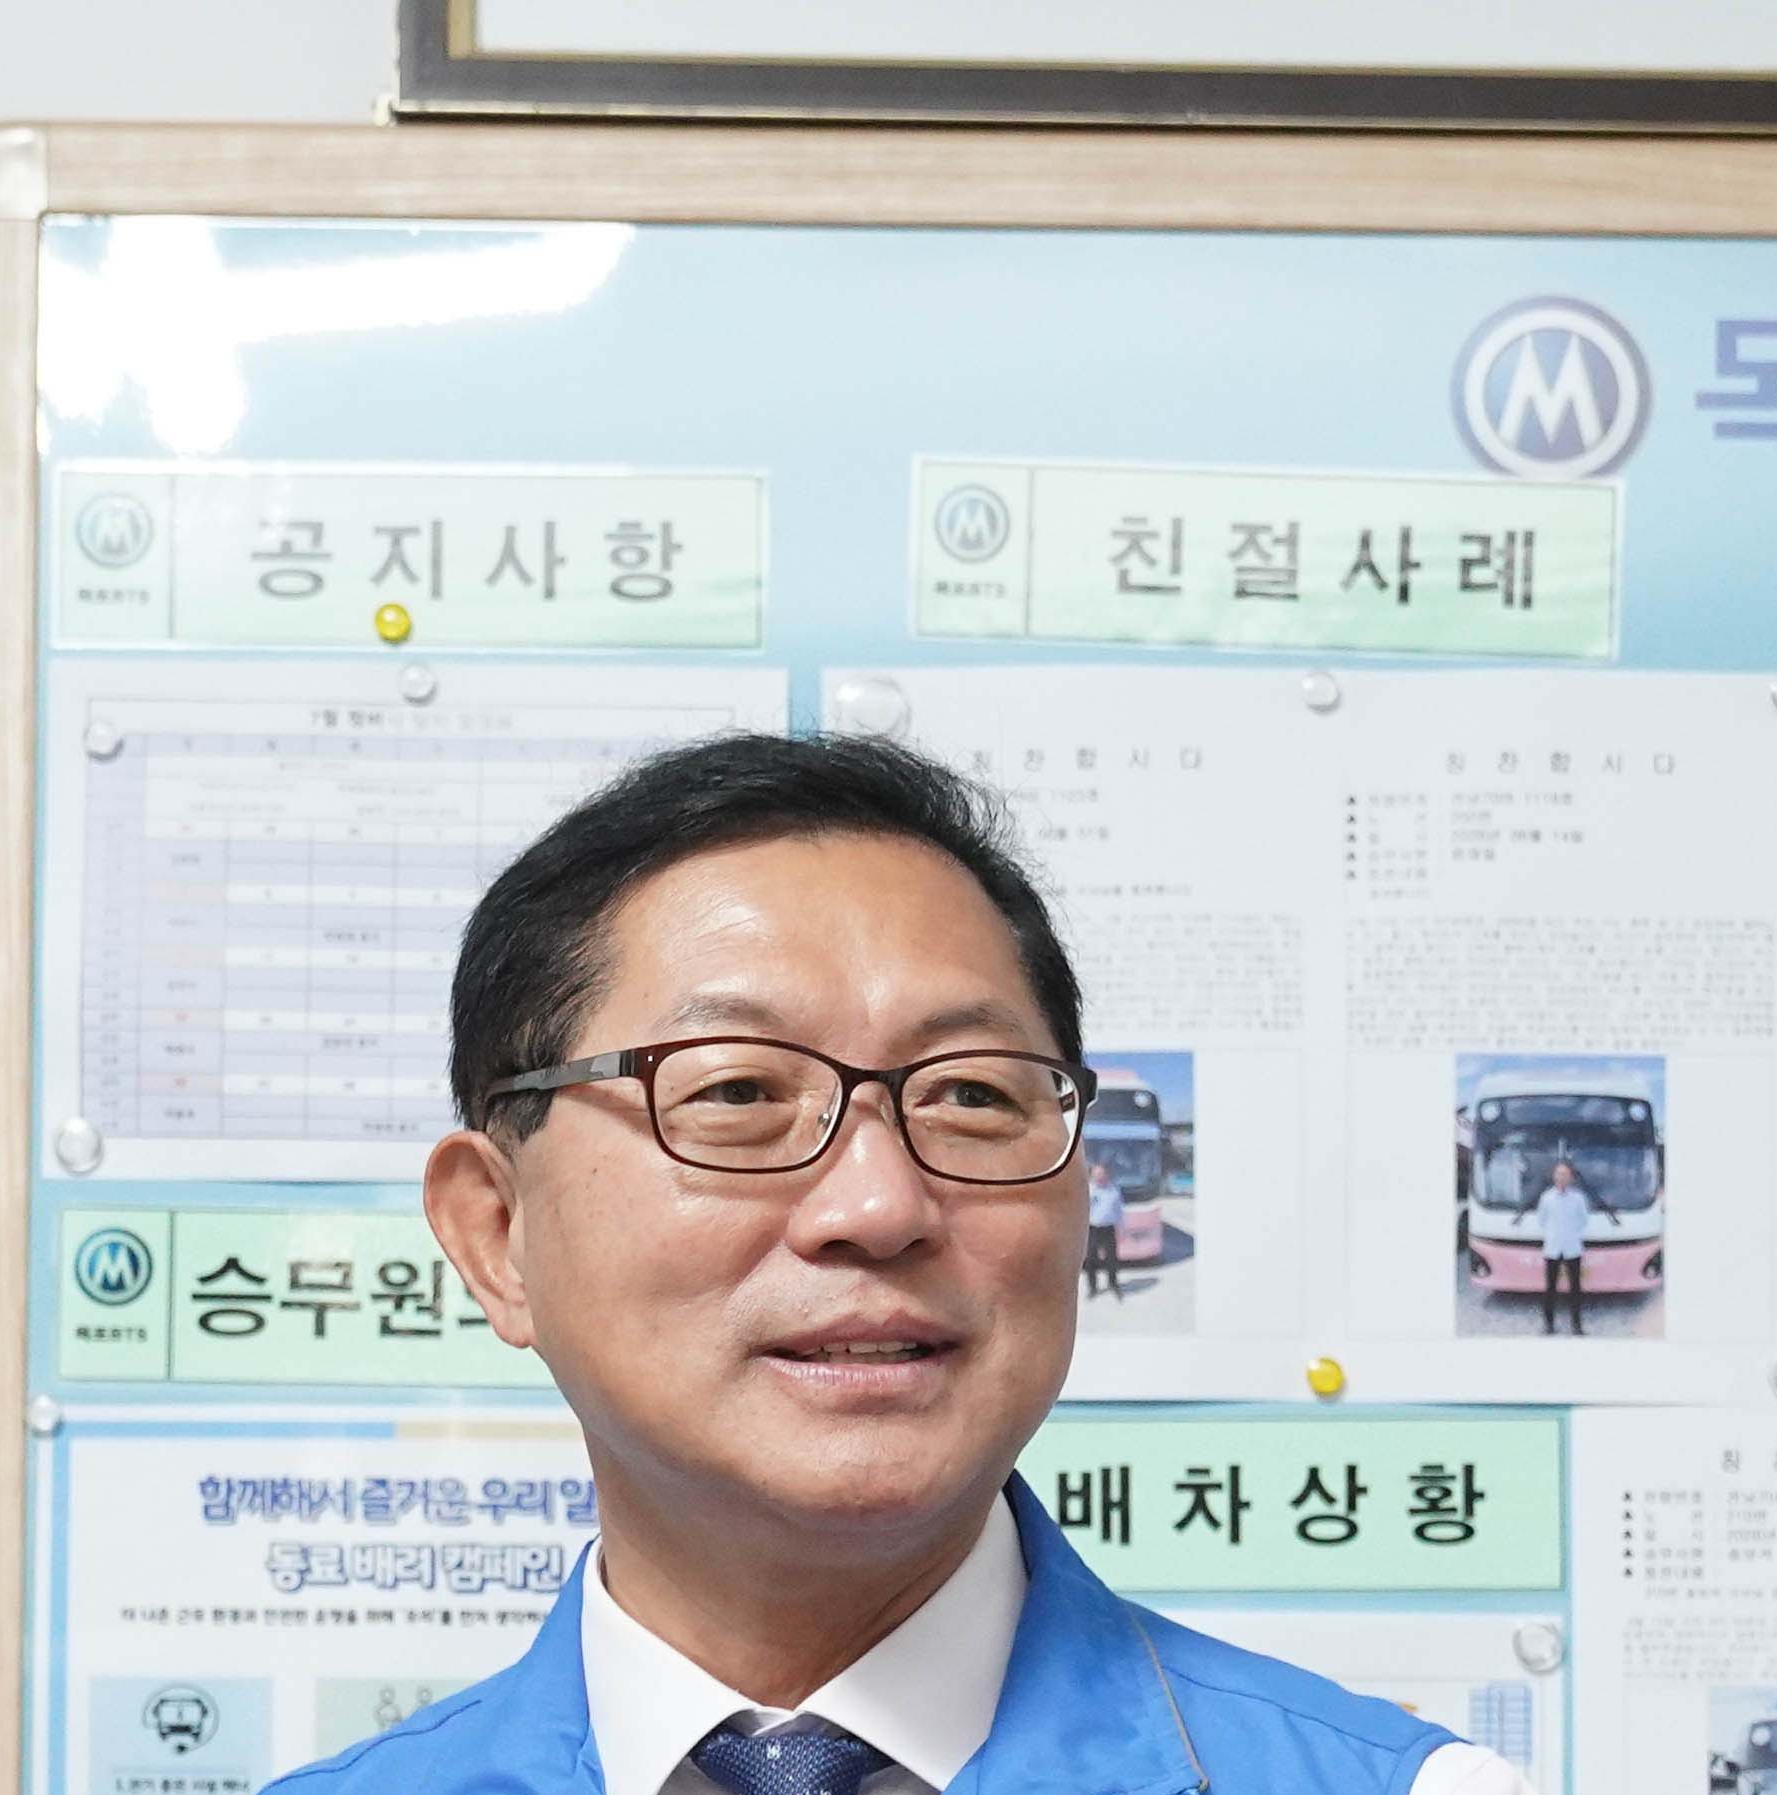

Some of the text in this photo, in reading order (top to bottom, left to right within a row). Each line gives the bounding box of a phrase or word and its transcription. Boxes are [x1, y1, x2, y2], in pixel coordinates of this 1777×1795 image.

[250, 519, 685, 601] 공지사항
[1110, 516, 1537, 610] 친절사례
[190, 1255, 490, 1340] 승무원
[199, 1474, 353, 1525] 함께해서
[360, 1474, 470, 1525] 즐거운
[478, 1475, 555, 1525] 우리
[1056, 1461, 1485, 1546] 배차상황
[265, 1541, 565, 1594] 동료 배려 캠페인
